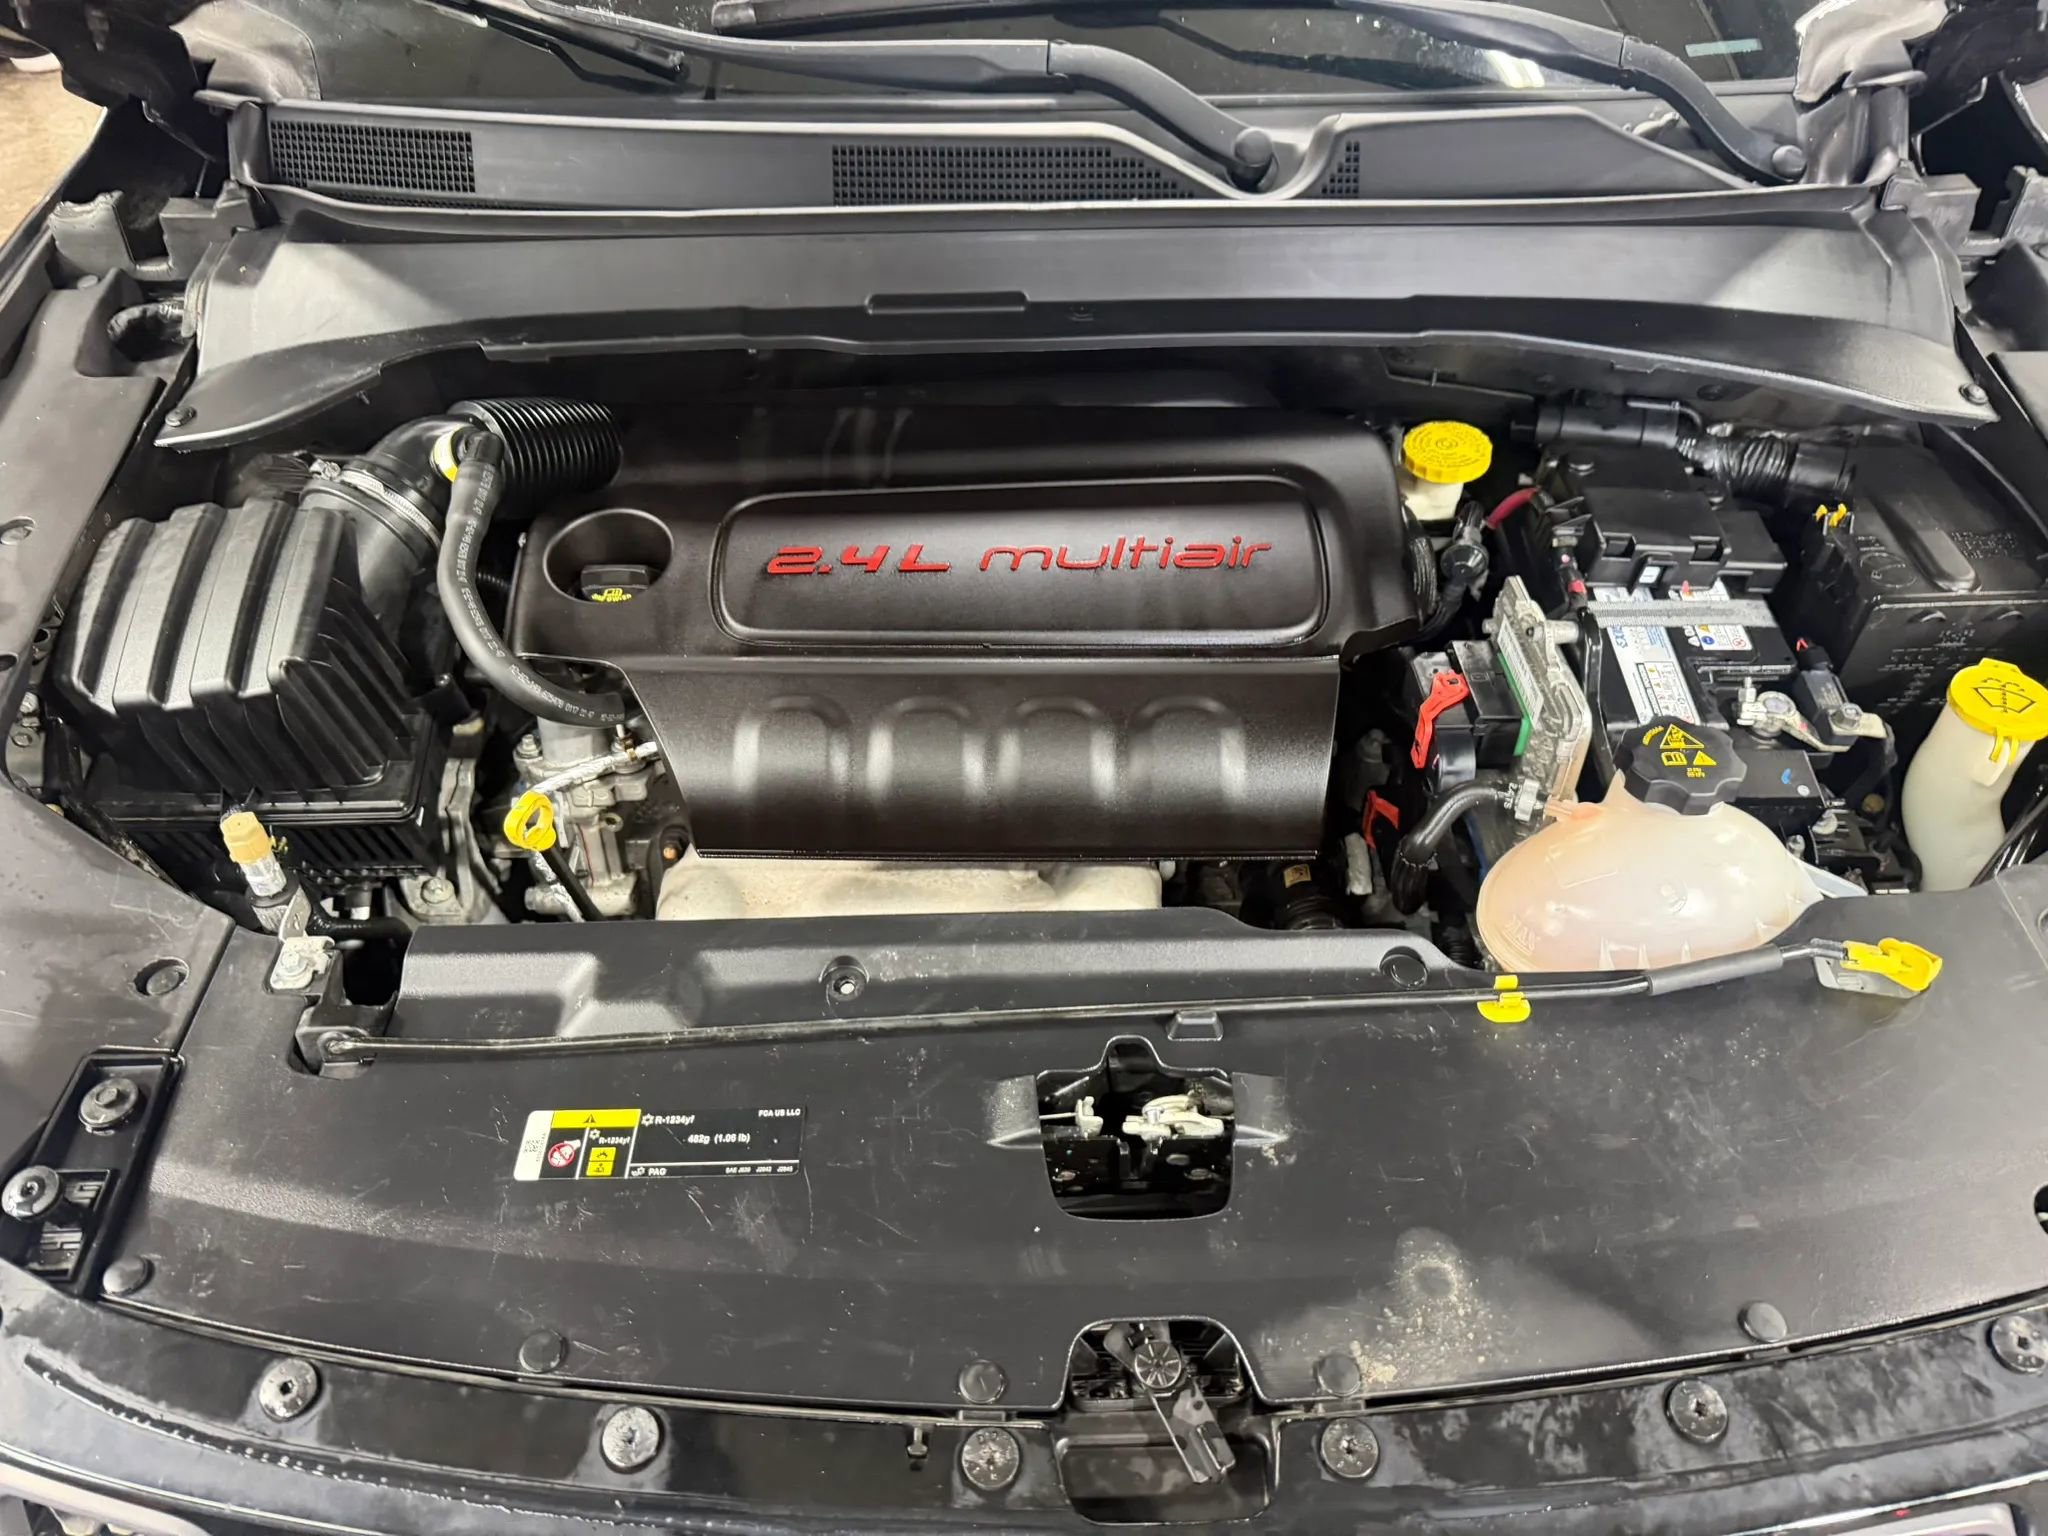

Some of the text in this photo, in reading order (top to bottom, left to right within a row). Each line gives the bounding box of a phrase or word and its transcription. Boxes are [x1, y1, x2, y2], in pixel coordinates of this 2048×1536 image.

[766, 534, 1273, 575] 2.4L multiair
[758, 1108, 801, 1118] FCA US LLC
[654, 1115, 696, 1126] R-1234yf
[737, 1133, 751, 1144] lb)
[647, 1167, 668, 1176] PAG
